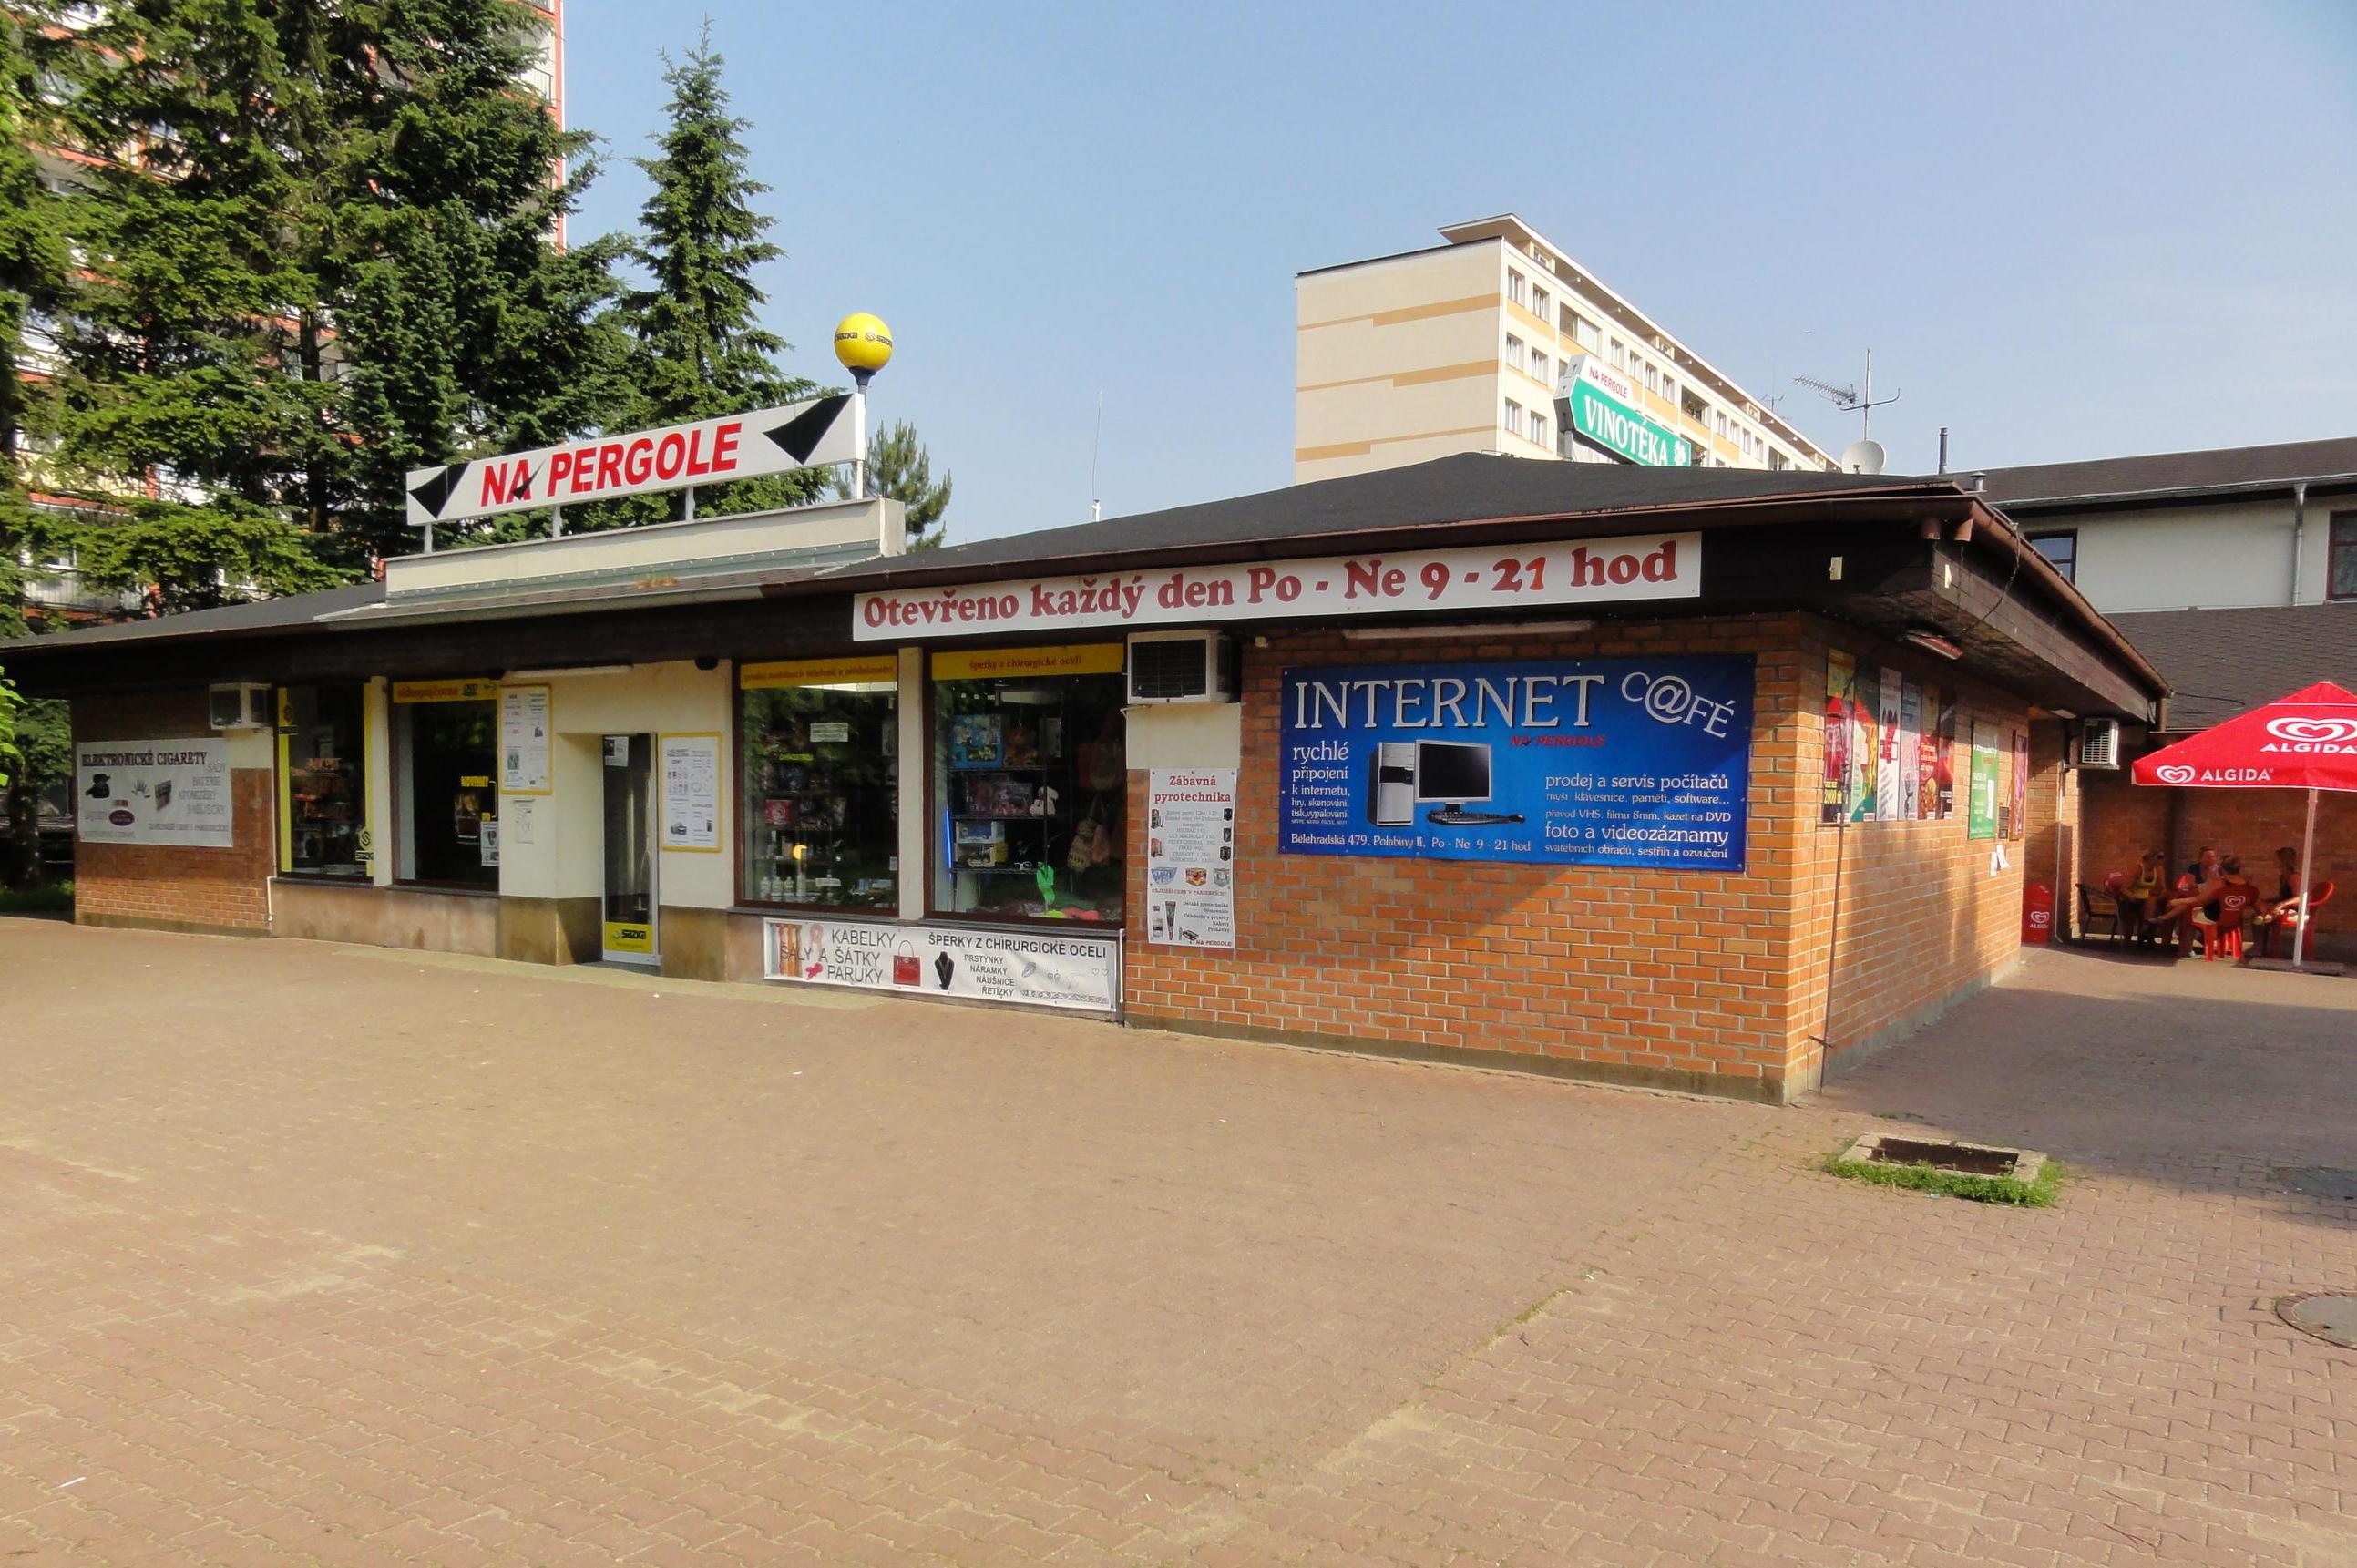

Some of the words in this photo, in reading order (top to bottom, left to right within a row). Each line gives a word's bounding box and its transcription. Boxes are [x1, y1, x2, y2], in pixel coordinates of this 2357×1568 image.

[1589, 365, 1600, 381] NA
[1600, 373, 1628, 398] PERGOLE
[1584, 394, 1668, 466] VINOTÉKA
[480, 458, 530, 507] NA
[548, 422, 743, 497] PERGOLE
[863, 589, 1020, 628] Otevřeno
[1030, 574, 1146, 620] každý
[1156, 573, 1235, 610] den
[1247, 567, 1302, 604] Po
[1343, 559, 1405, 600] Ne
[1420, 561, 1450, 601] 9
[1491, 556, 1546, 593] 21
[1570, 539, 1678, 588] hod
[1294, 674, 1605, 730] INTERNET
[1621, 671, 1736, 738] C@FÉ
[1536, 734, 1605, 747] PERGOLE
[2260, 743, 2357, 754] ALGIDA
[81, 749, 154, 767] ELEKTRONICKÉ
[157, 751, 208, 766] CIGARETY
[1293, 740, 1348, 764] rychlé
[1169, 774, 1217, 786] Zábavná
[1292, 766, 1348, 782] připojení
[1545, 772, 1593, 791] prodej
[1597, 776, 1606, 787] a
[1611, 774, 1655, 788] servis
[1660, 774, 1729, 792] počítačů
[2200, 768, 2271, 782] ALGIDA
[1154, 791, 1231, 804] pyrotechnika
[1292, 784, 1298, 795] k
[1301, 784, 1351, 797] internetu,
[1606, 809, 1630, 820] filmu
[1663, 810, 1688, 821] kazet
[1690, 814, 1703, 822] na
[1706, 811, 1732, 823] DVD
[1291, 833, 1346, 845] Bělehradská
[1373, 835, 1414, 848] Polabiny
[1431, 838, 1445, 848] Po
[1455, 838, 1471, 848] Ne
[1476, 838, 1483, 849] 9
[1494, 839, 1507, 851] 21
[1511, 841, 1531, 852] hod
[1545, 821, 1580, 839] foto
[1584, 826, 1595, 839] a
[1601, 823, 1729, 847] videozáznamy
[1637, 845, 1670, 856] sestřih
[1682, 847, 1728, 859] ozvučení
[831, 928, 896, 948] KABELKY
[928, 932, 973, 948] ŠPERKY
[976, 937, 982, 949] Z
[985, 938, 1067, 956] CHIRURGICKÉ
[1070, 944, 1107, 958] OCELI
[818, 948, 828, 963] A
[835, 946, 881, 967] ŠÁTKY
[827, 965, 883, 985] PARUKY
